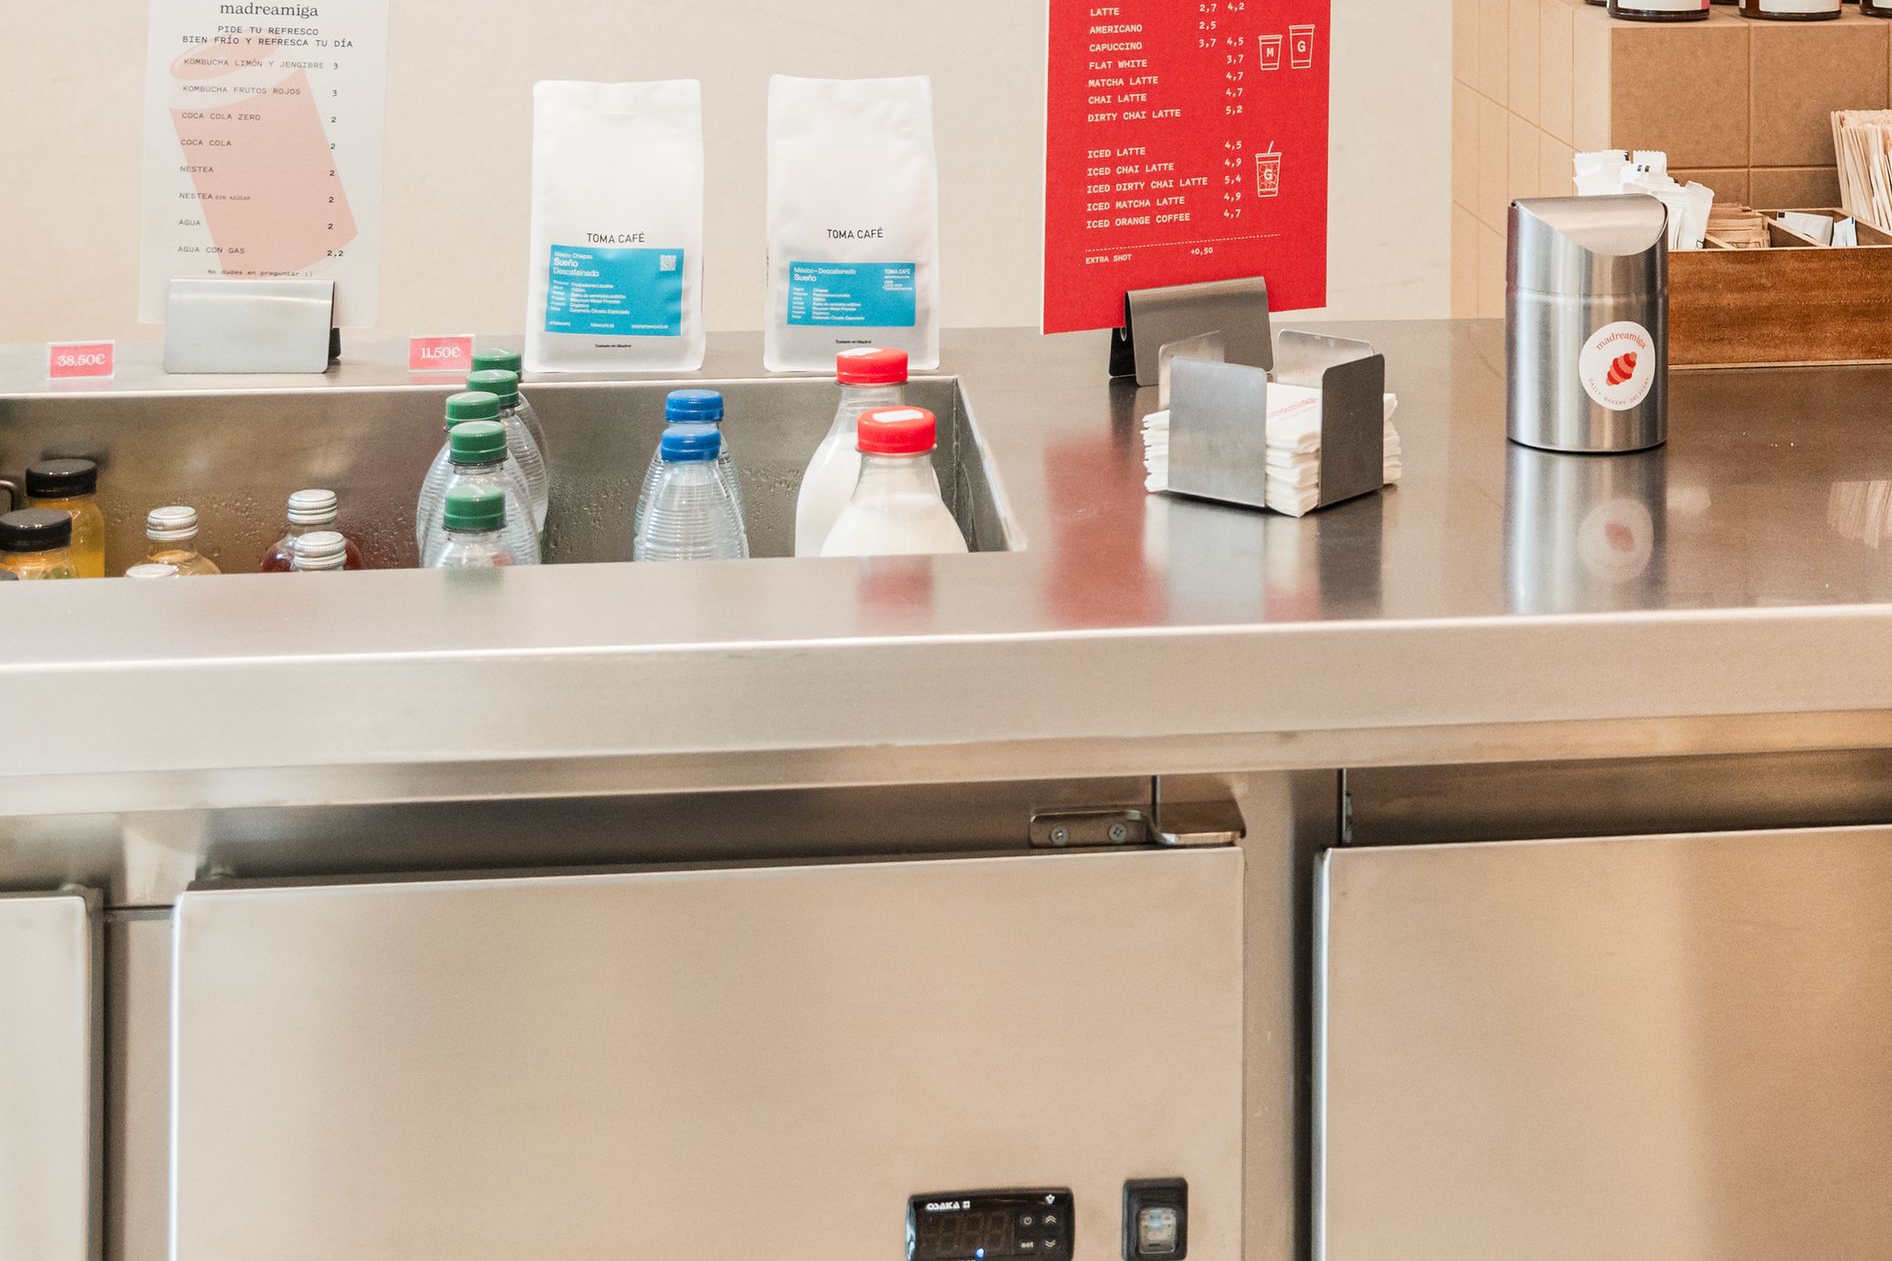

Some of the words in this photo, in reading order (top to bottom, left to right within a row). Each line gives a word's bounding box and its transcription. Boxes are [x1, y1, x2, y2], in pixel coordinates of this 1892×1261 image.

[220, 2, 319, 19] madreamiga
[1090, 8, 1120, 16] LATTE
[1200, 4, 1217, 13] 2,7
[1227, 3, 1244, 11] 4,2
[218, 25, 242, 33] PIDE
[268, 27, 319, 36] REFRESCO
[1090, 24, 1142, 34] AMERICANO
[1200, 21, 1216, 30] 2,5
[214, 34, 239, 44] FRÍO
[258, 38, 309, 46] REFRESCA
[334, 38, 353, 48] DÍA
[1089, 42, 1142, 52] CAPUCCINO
[1199, 39, 1216, 47] 3,7
[1226, 37, 1244, 47] 4,5
[1297, 41, 1306, 53] G
[1266, 48, 1274, 57] M
[235, 58, 262, 67] LIMÓN
[280, 61, 324, 69] JENGIBRE
[1089, 61, 1112, 70] FLAT
[1118, 59, 1147, 68] WHITE
[1227, 55, 1244, 64] 3,7
[1088, 78, 1124, 87] MATCHA
[1130, 76, 1158, 85] LATTE
[1226, 72, 1243, 81] 4,7
[1088, 95, 1112, 104] CHAI
[1118, 93, 1147, 103] LATTE
[1226, 88, 1243, 97] 4,7
[1088, 113, 1117, 122] DIRTY
[1123, 111, 1146, 120] CHAI
[1152, 109, 1180, 118] LATTE
[1226, 105, 1242, 115] 5,2
[1088, 149, 1111, 158] ICED
[1116, 147, 1146, 156] LATTE
[1224, 141, 1242, 150] 4,5
[1087, 167, 1110, 176] ICED
[1116, 165, 1139, 174] CHAI
[1145, 163, 1174, 172] LATTE
[1224, 158, 1242, 167] 4,9
[1264, 169, 1273, 180] G
[1087, 185, 1110, 193] ICED
[1116, 182, 1145, 191] DIRTY
[1151, 179, 1174, 188] CHAI
[1180, 177, 1208, 187] LATTE
[1224, 175, 1242, 184] 5,4
[1087, 203, 1110, 211] ICED
[1116, 199, 1150, 209] MATCHA
[1156, 197, 1184, 207] LATTE
[1224, 193, 1241, 201] 4,9
[1086, 219, 1110, 229] ICED
[1115, 217, 1150, 227] ORANGE
[1156, 213, 1190, 223] COFFEE
[1224, 209, 1241, 219] 4,7
[587, 233, 615, 243] TOMA
[618, 232, 644, 243] CAFÉ
[827, 229, 854, 239] TOMA
[857, 228, 883, 239] CAFÉ
[554, 257, 578, 267] Sueño
[1086, 256, 1109, 264] EXTRA
[1113, 254, 1132, 262] SHOT
[1190, 247, 1213, 255] +0,50
[1596, 332, 1646, 350] madreamiga
[421, 347, 461, 359] 11,50€
[926, 1201, 960, 1211] OSAKA
